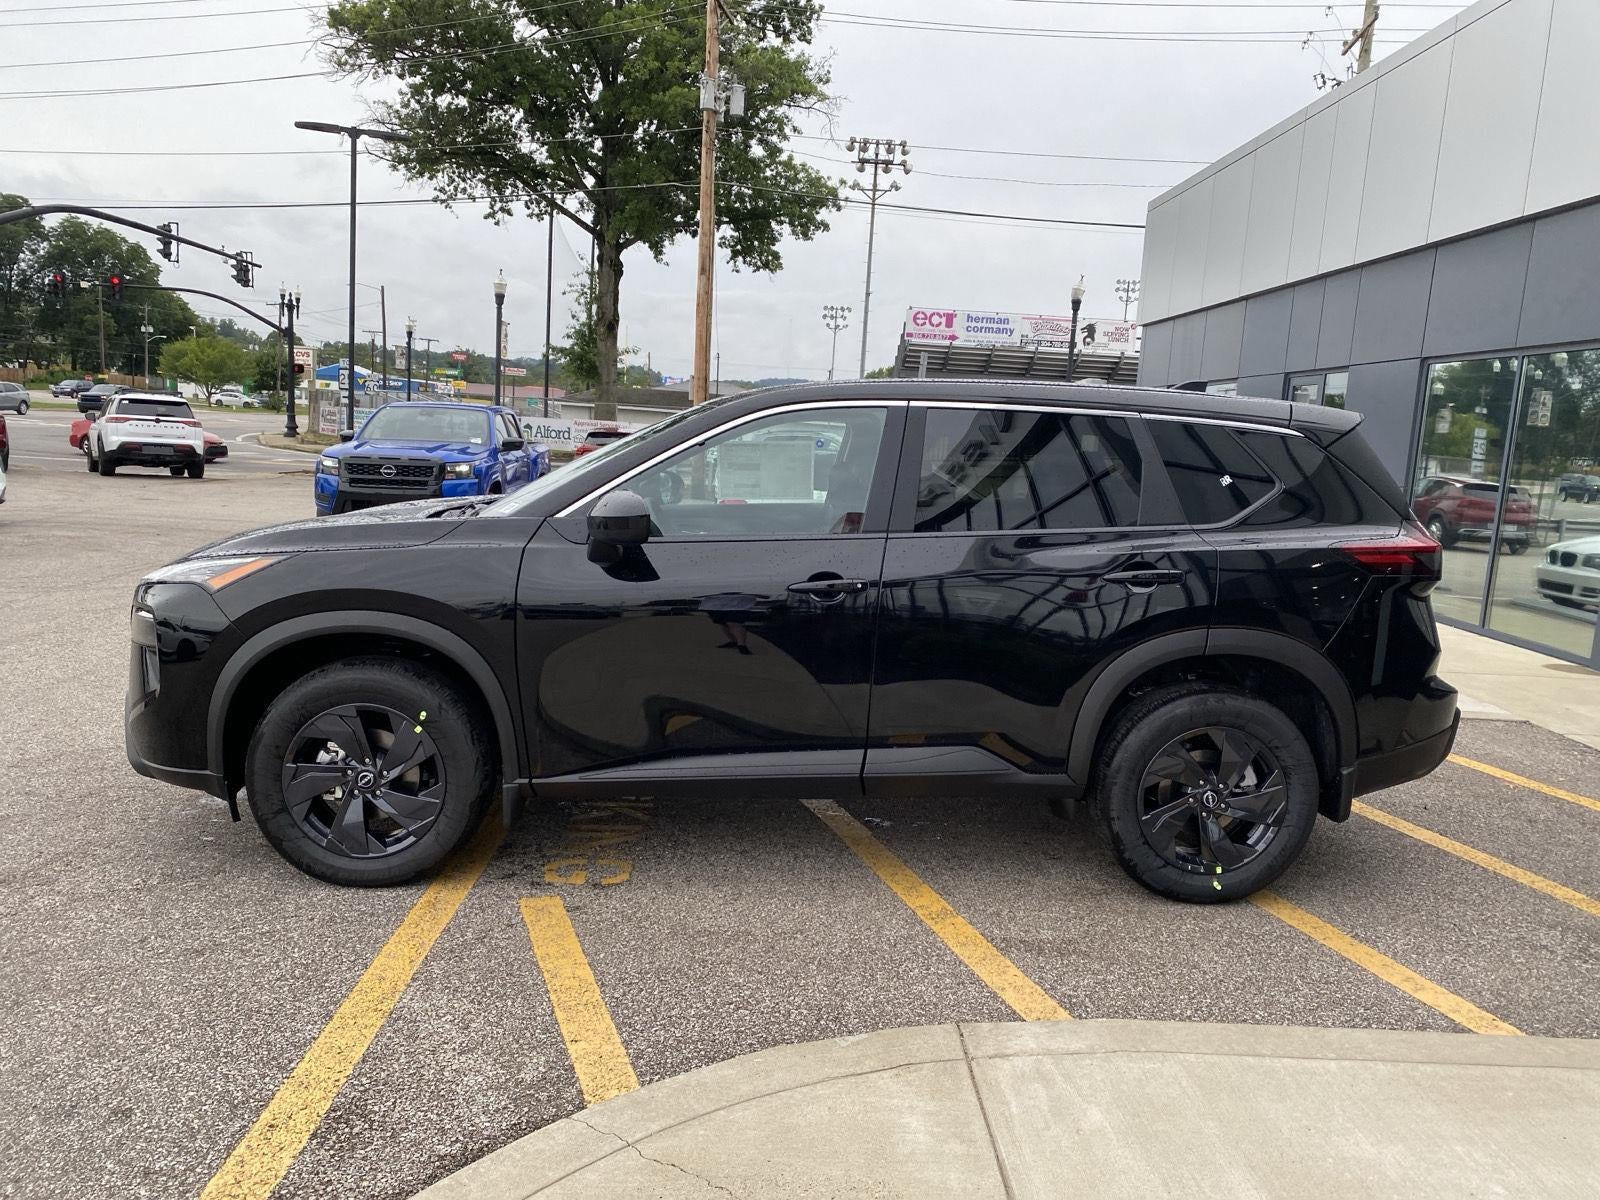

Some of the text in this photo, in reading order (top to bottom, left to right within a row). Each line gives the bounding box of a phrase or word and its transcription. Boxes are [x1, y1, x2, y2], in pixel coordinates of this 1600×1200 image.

[966, 313, 1010, 325] herman
[966, 325, 1015, 337] cormany
[295, 350, 311, 358] CVS
[573, 419, 599, 428] Appraisal
[534, 424, 572, 441] Alford
[1219, 474, 1233, 487] RR
